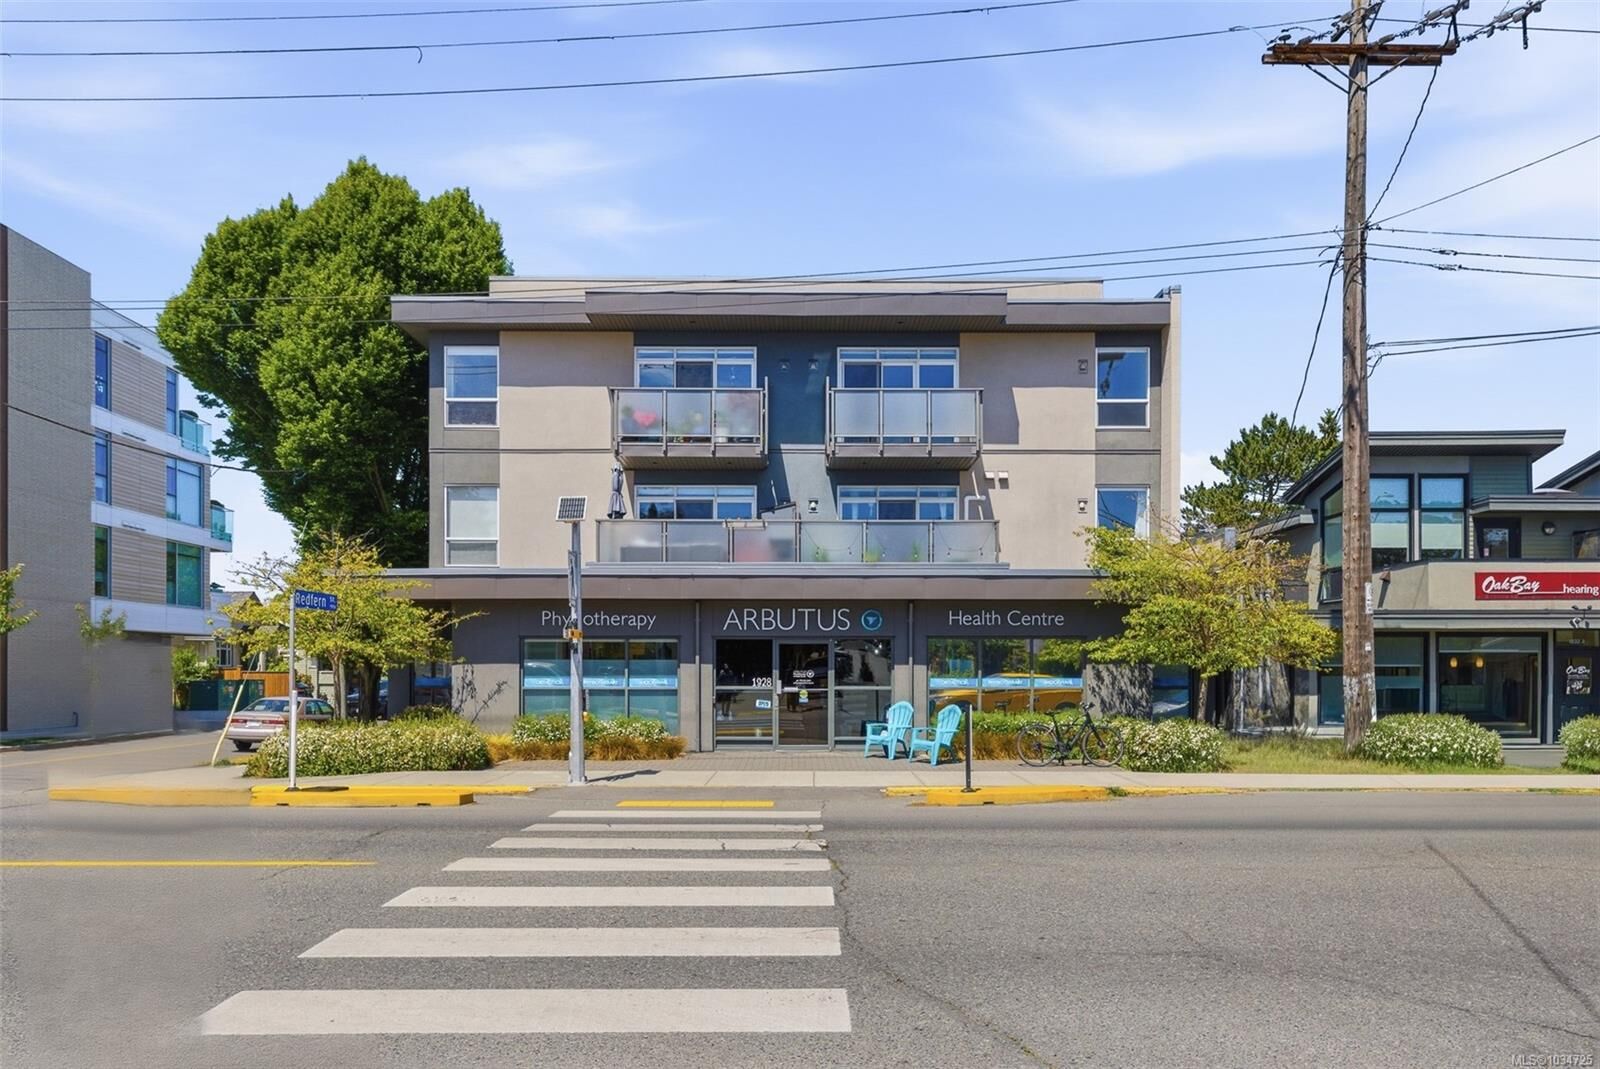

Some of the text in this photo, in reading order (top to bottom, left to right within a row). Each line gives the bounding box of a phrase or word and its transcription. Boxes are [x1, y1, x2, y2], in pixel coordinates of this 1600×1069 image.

[1563, 584, 1599, 596] hearing
[295, 592, 327, 607] Redfern
[541, 610, 656, 630] Phyotherapy
[723, 608, 850, 631] ARBUTUS
[948, 610, 1065, 626] Health Centre
[752, 677, 772, 688] 1928
